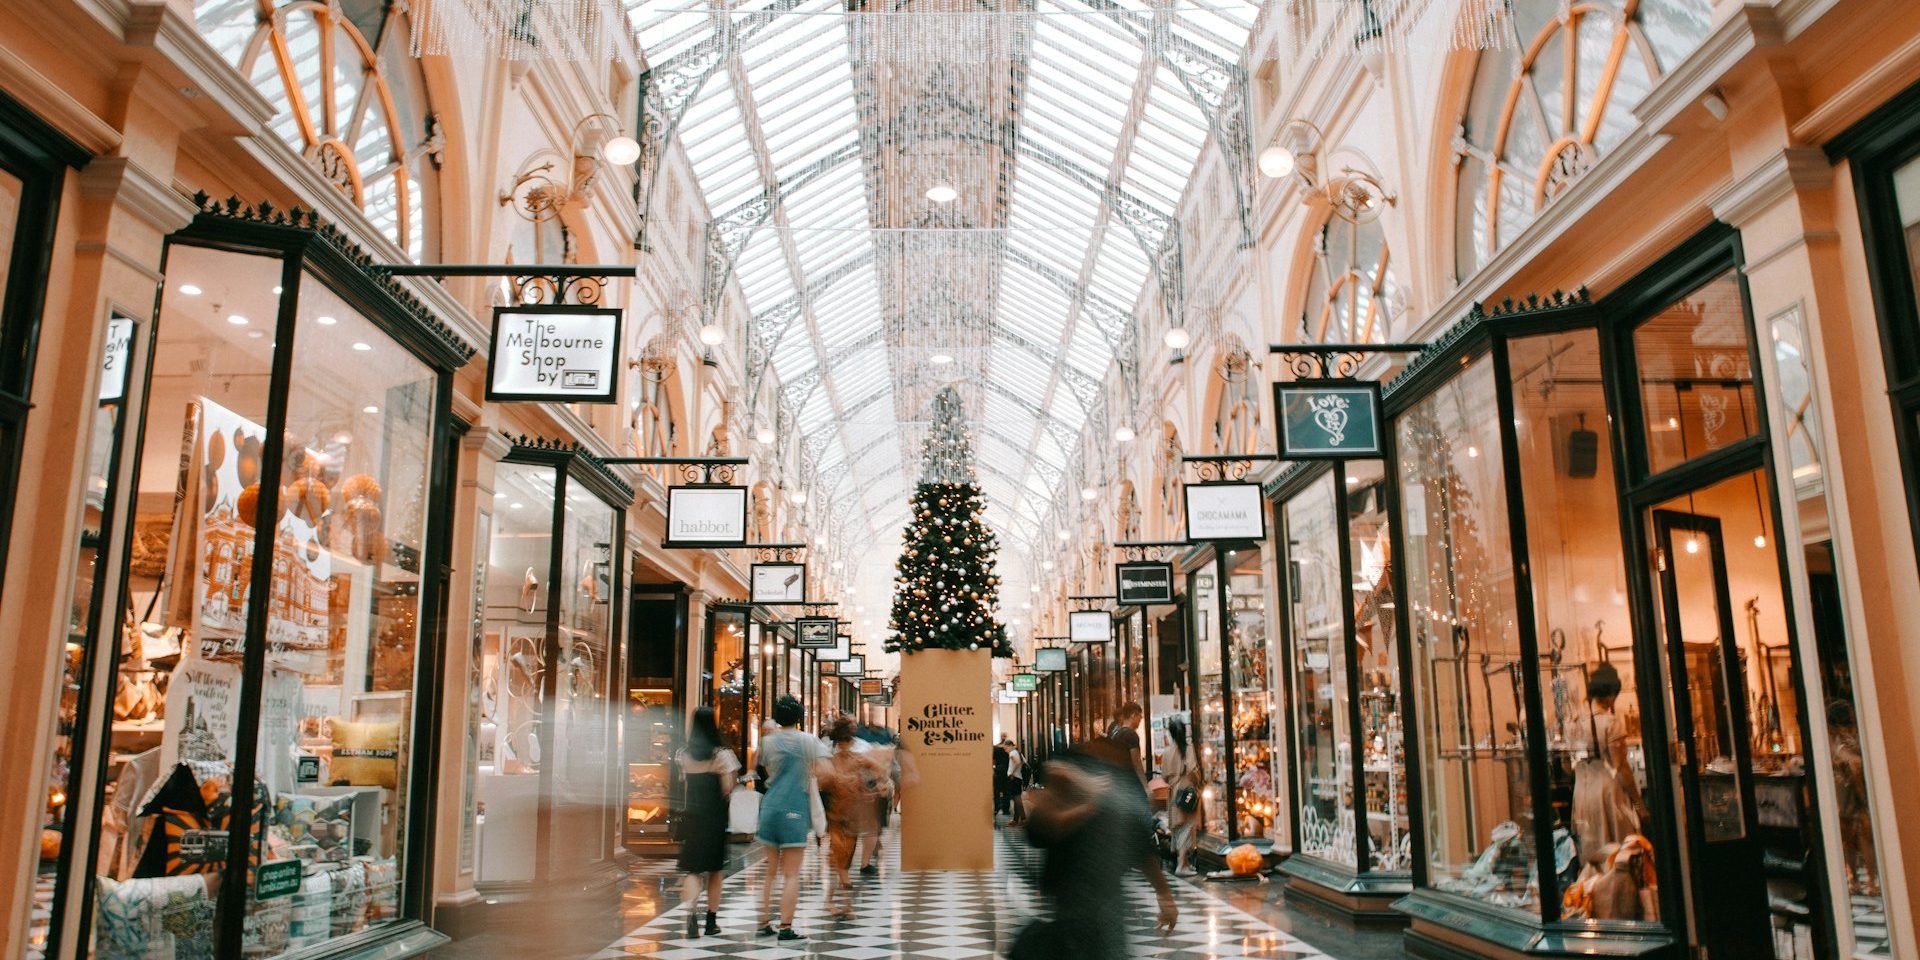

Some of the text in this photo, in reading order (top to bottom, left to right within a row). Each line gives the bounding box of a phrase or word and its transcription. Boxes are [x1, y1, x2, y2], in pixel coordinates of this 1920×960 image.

[525, 319, 556, 334] The
[506, 333, 603, 349] Melbourne
[521, 350, 566, 370] Shop
[537, 372, 558, 386] by
[1197, 510, 1248, 521] CHOCAMAMA
[679, 519, 733, 533] habbot.
[923, 703, 975, 719] Glitter.
[907, 716, 963, 732] Sparkle
